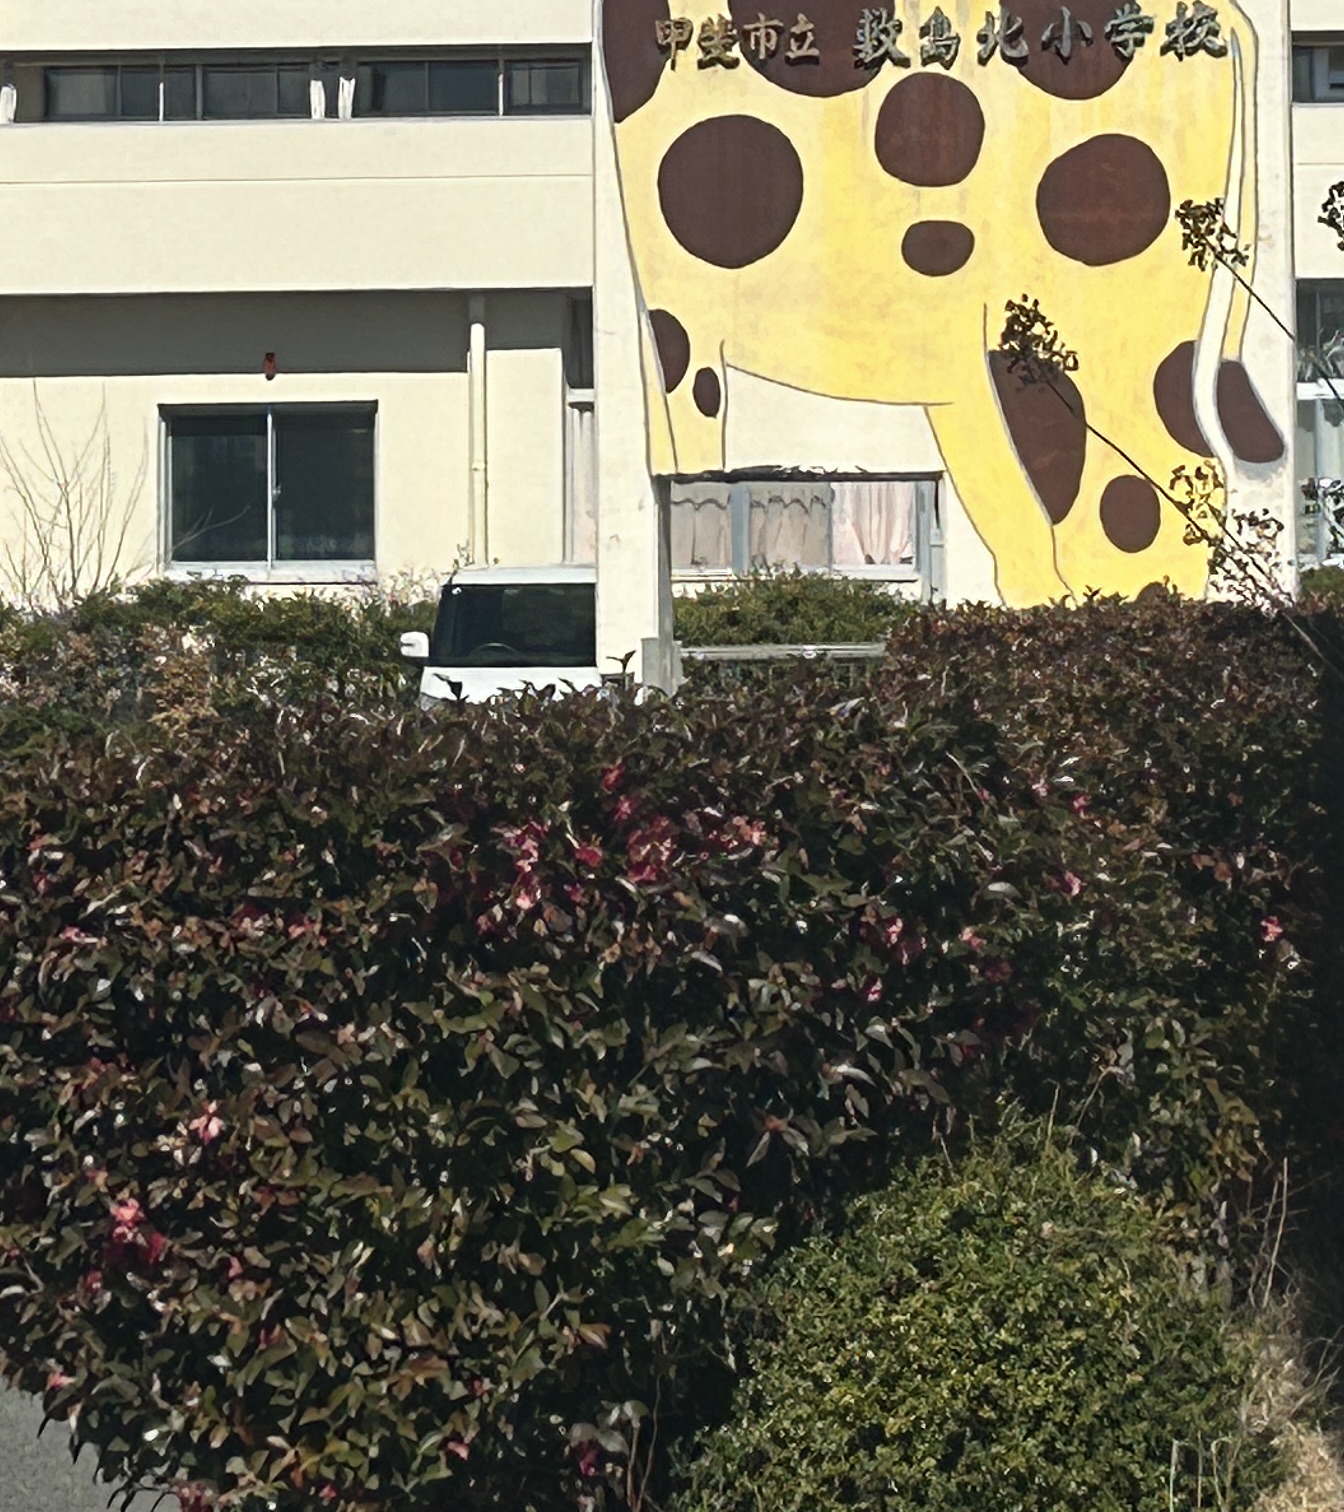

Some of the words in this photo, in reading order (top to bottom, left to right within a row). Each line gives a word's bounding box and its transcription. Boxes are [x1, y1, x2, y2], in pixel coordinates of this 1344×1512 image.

[852, 0, 1229, 71] 敷島北小学校
